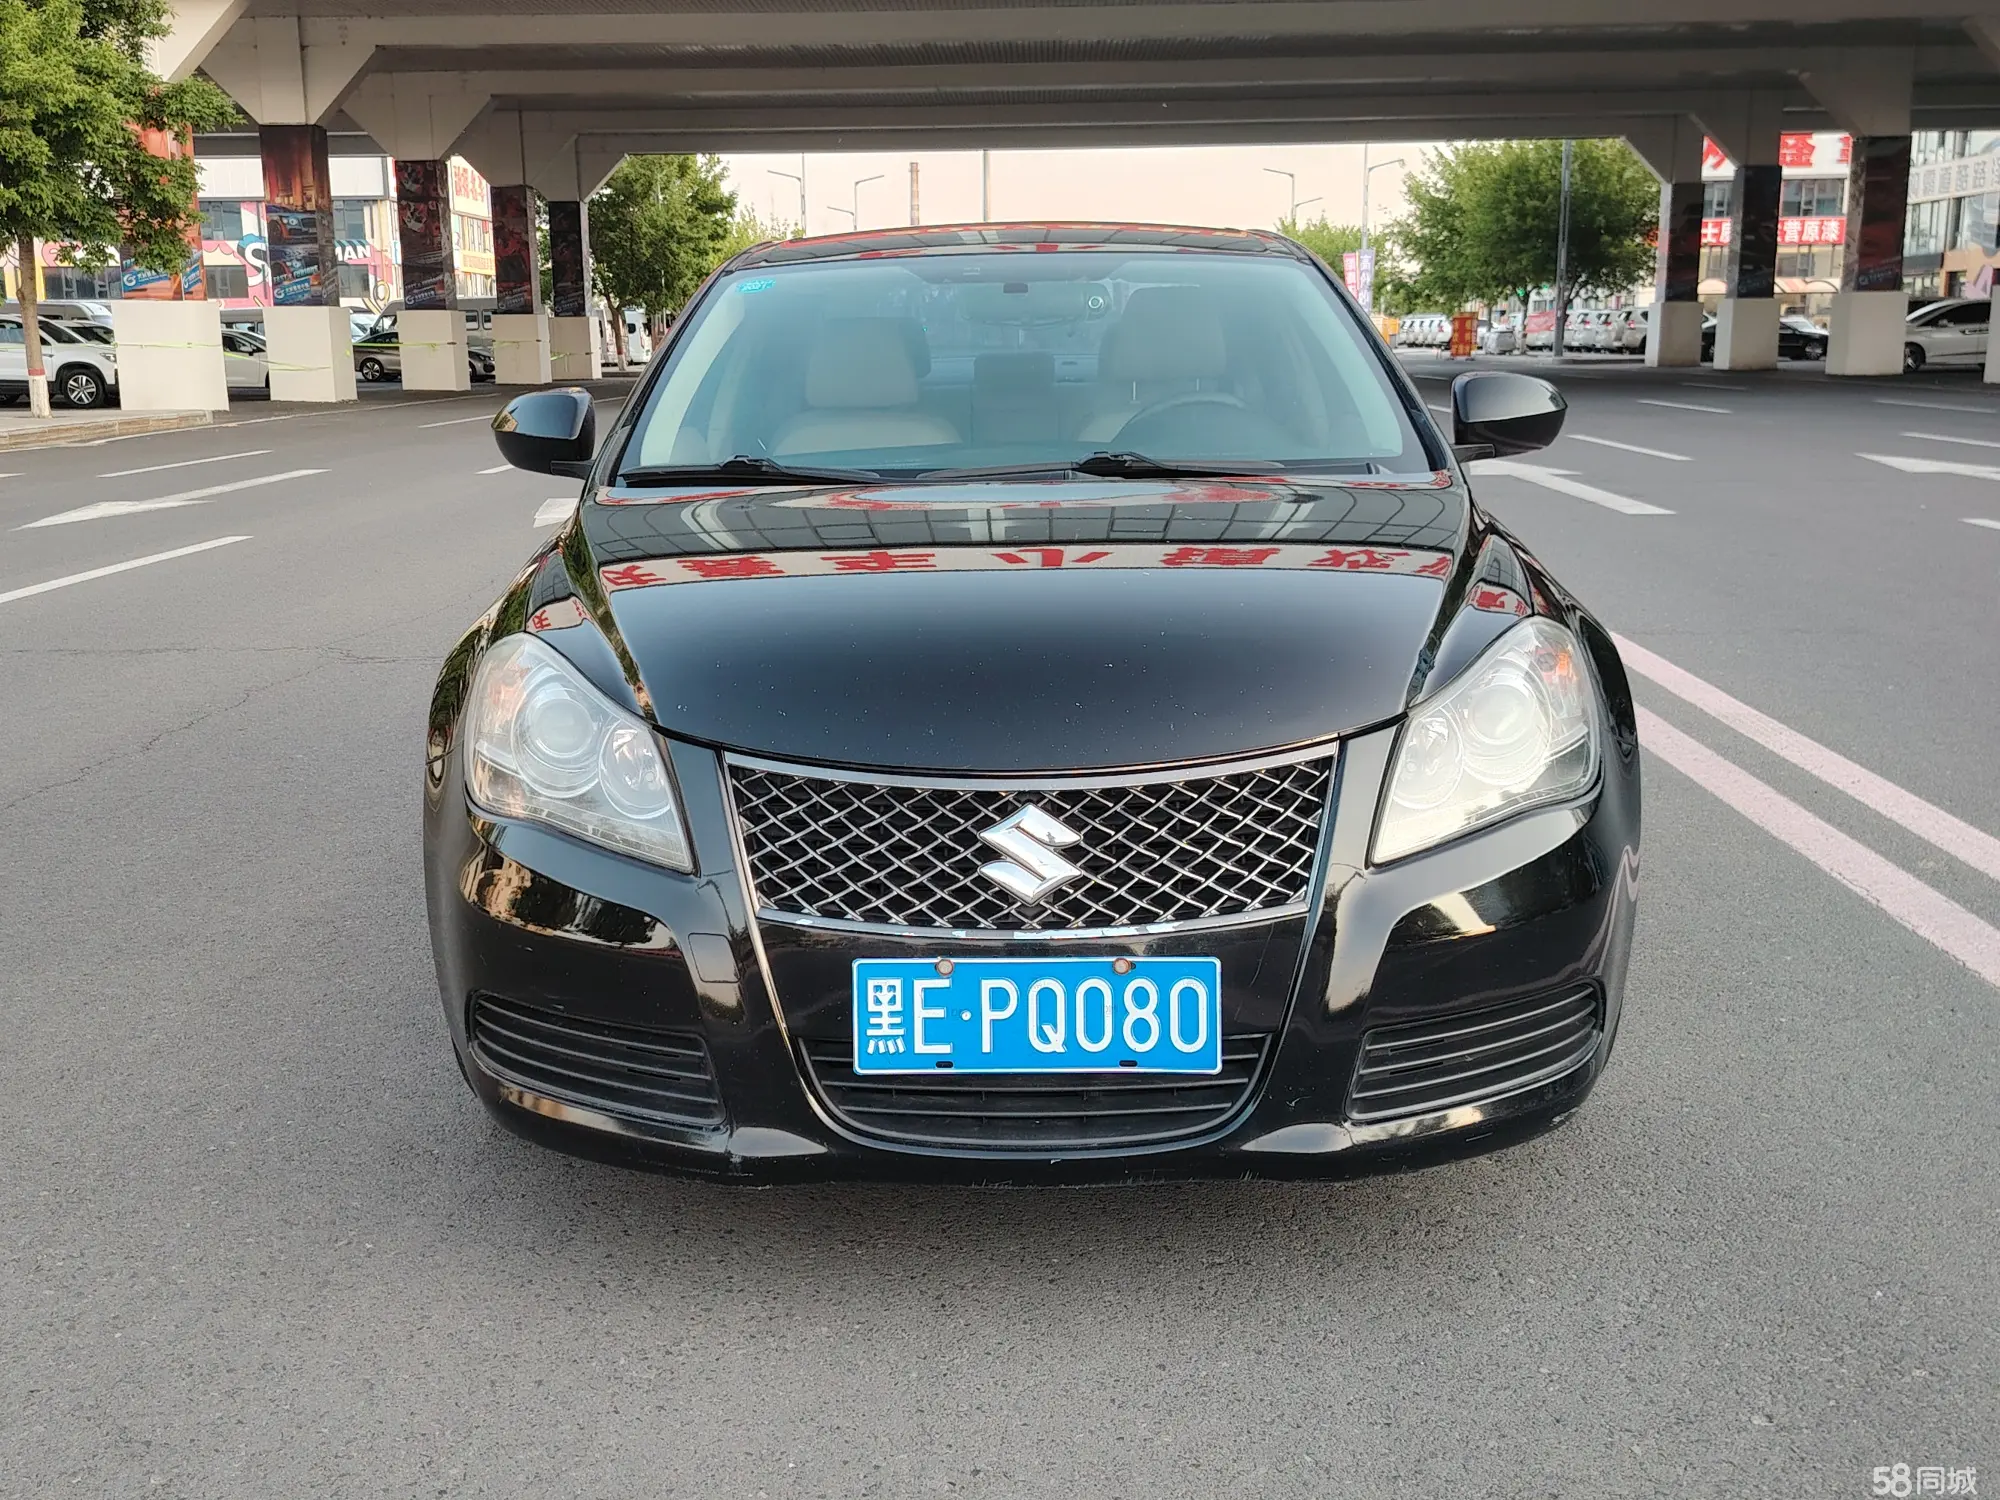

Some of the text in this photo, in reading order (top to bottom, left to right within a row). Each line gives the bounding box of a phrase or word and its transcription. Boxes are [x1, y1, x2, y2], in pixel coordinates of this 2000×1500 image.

[1777, 219, 1841, 243] 营原漆
[866, 976, 1208, 1055] 黑E·PQ080
